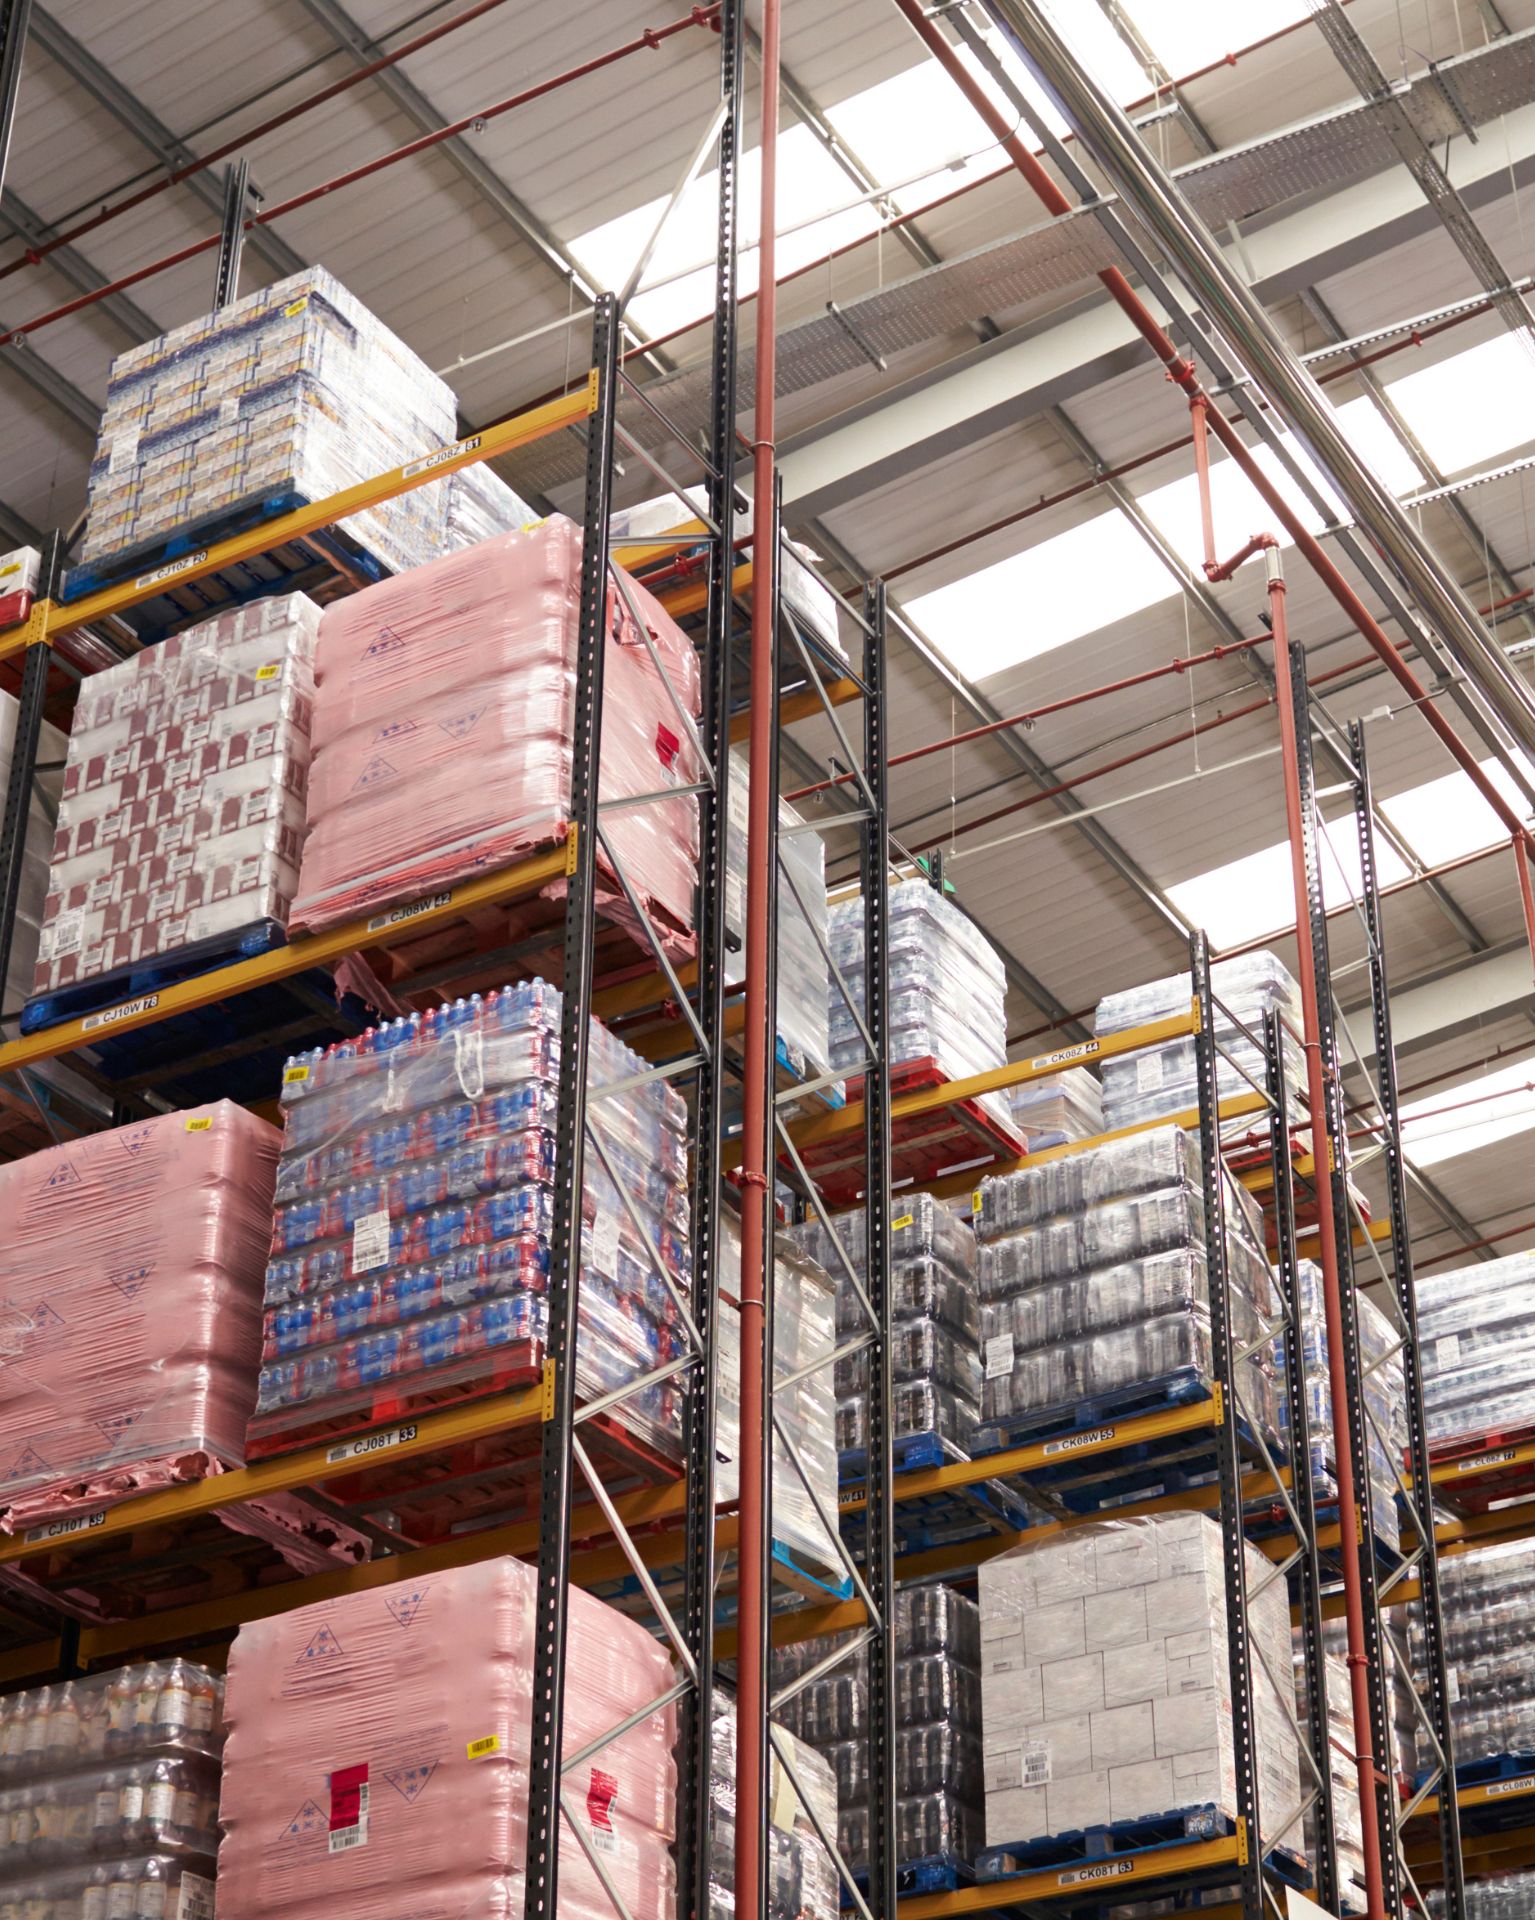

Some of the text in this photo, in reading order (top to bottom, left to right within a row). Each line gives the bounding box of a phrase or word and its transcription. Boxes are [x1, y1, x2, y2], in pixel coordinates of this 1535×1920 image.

[426, 446, 461, 467] CJ08Z
[157, 560, 190, 579] CJ10Z
[390, 892, 451, 922] CJ08W 42
[103, 996, 158, 1023] CJ10W 78
[1051, 1042, 1099, 1063] CK08Z 44
[354, 1426, 416, 1454] CJ08T 33
[1062, 1428, 1114, 1449] CK08W 55
[48, 1511, 104, 1537] CJ10T 39
[1502, 1778, 1532, 1792] CL08W
[1079, 1861, 1132, 1881] CK08T 63
